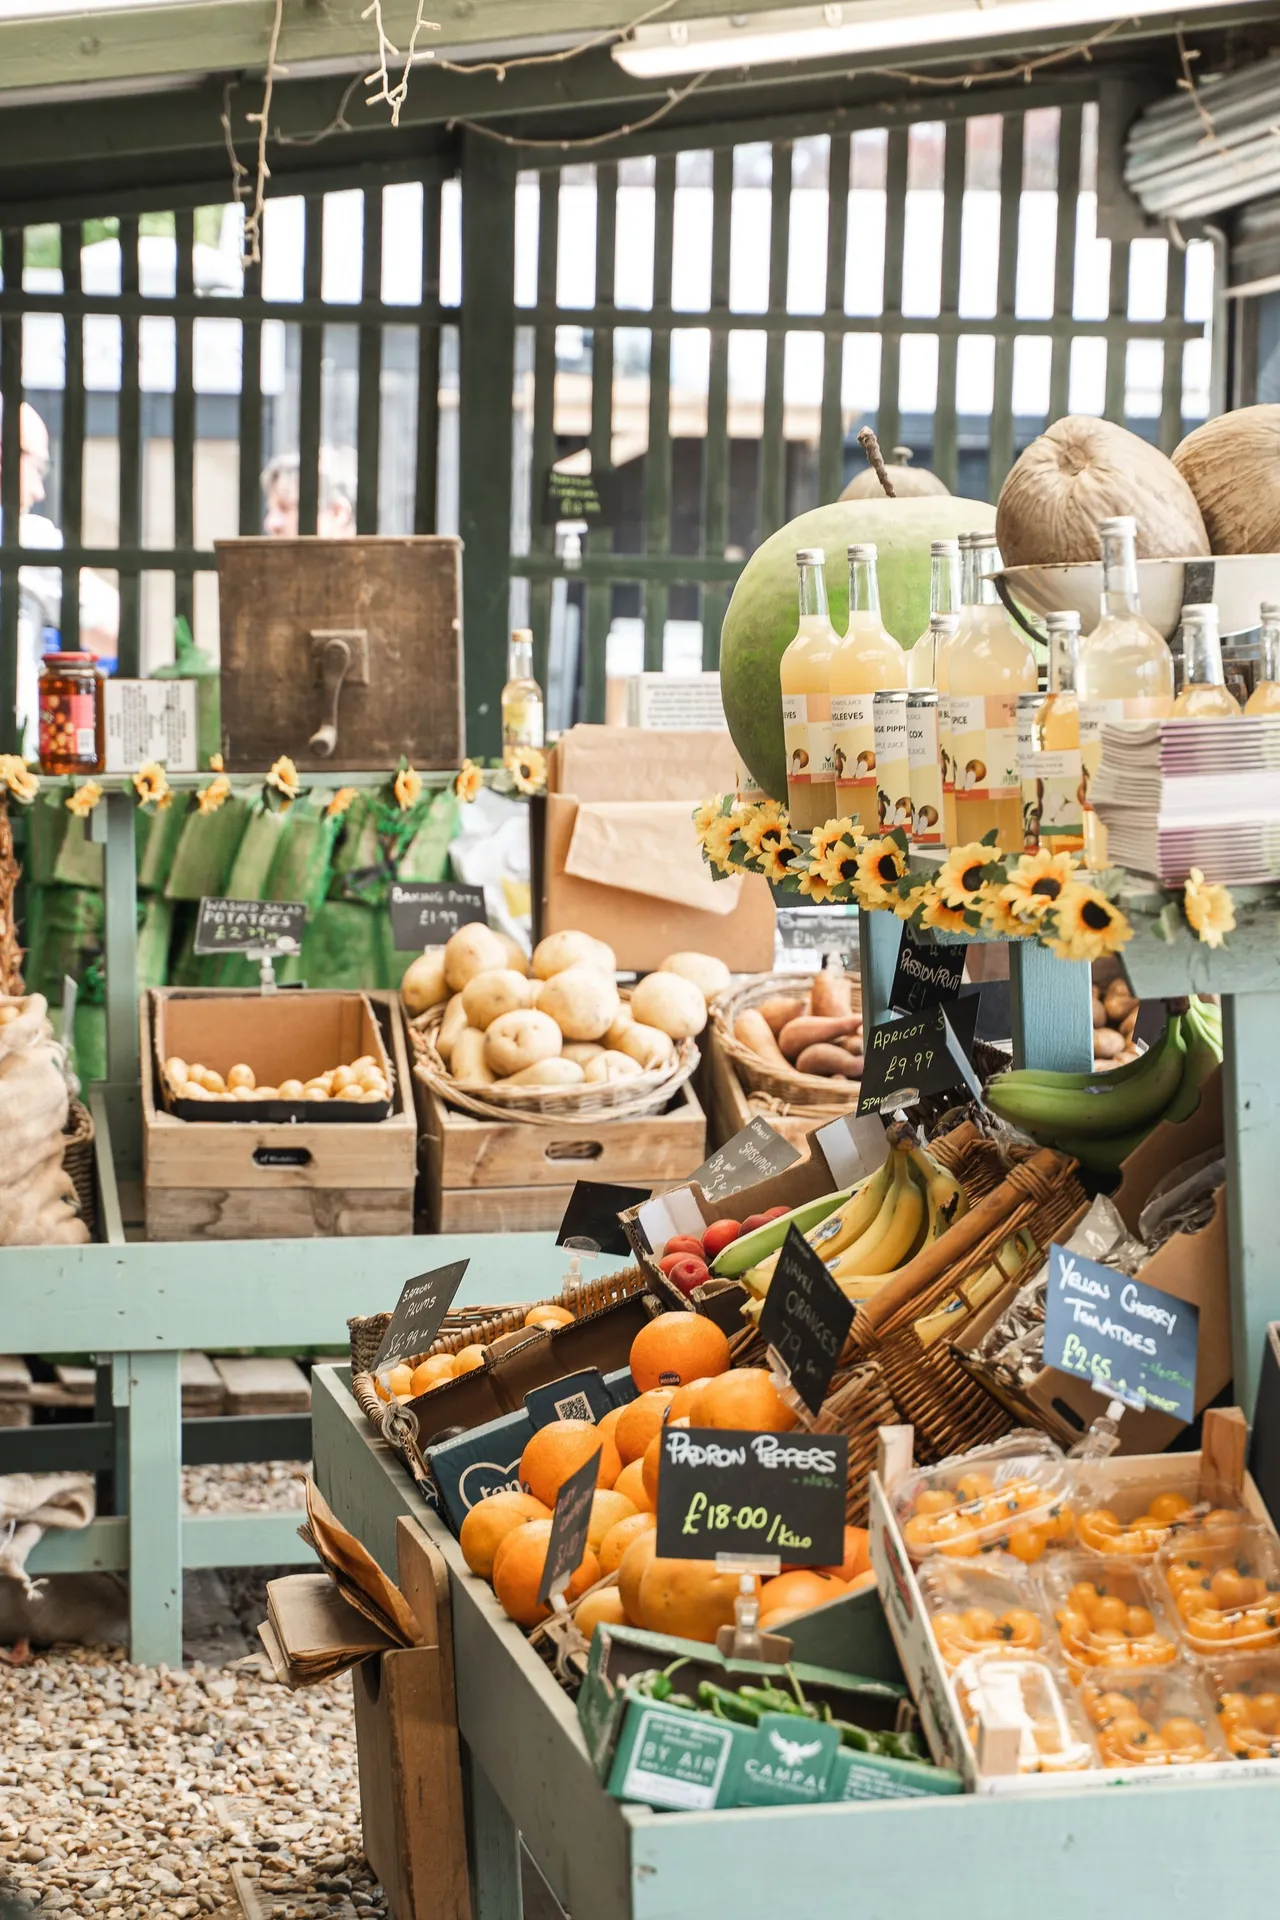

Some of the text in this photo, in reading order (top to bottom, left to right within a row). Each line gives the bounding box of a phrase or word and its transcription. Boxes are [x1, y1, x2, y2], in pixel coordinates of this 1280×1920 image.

[203, 910, 291, 928] POTATOES
[873, 1023, 926, 1050] APRICOT
[884, 1050, 934, 1083] £9.99
[739, 1141, 777, 1176] SATSUMAS
[405, 1296, 437, 1319] PLUMS
[785, 1290, 838, 1358] ORANGES
[1063, 1297, 1158, 1356] TOMATOES
[665, 1431, 838, 1474] PADRON PEPPERS
[641, 1741, 671, 1762] BY
[678, 1751, 717, 1772] AIR
[744, 1758, 827, 1794] CAMPAL
